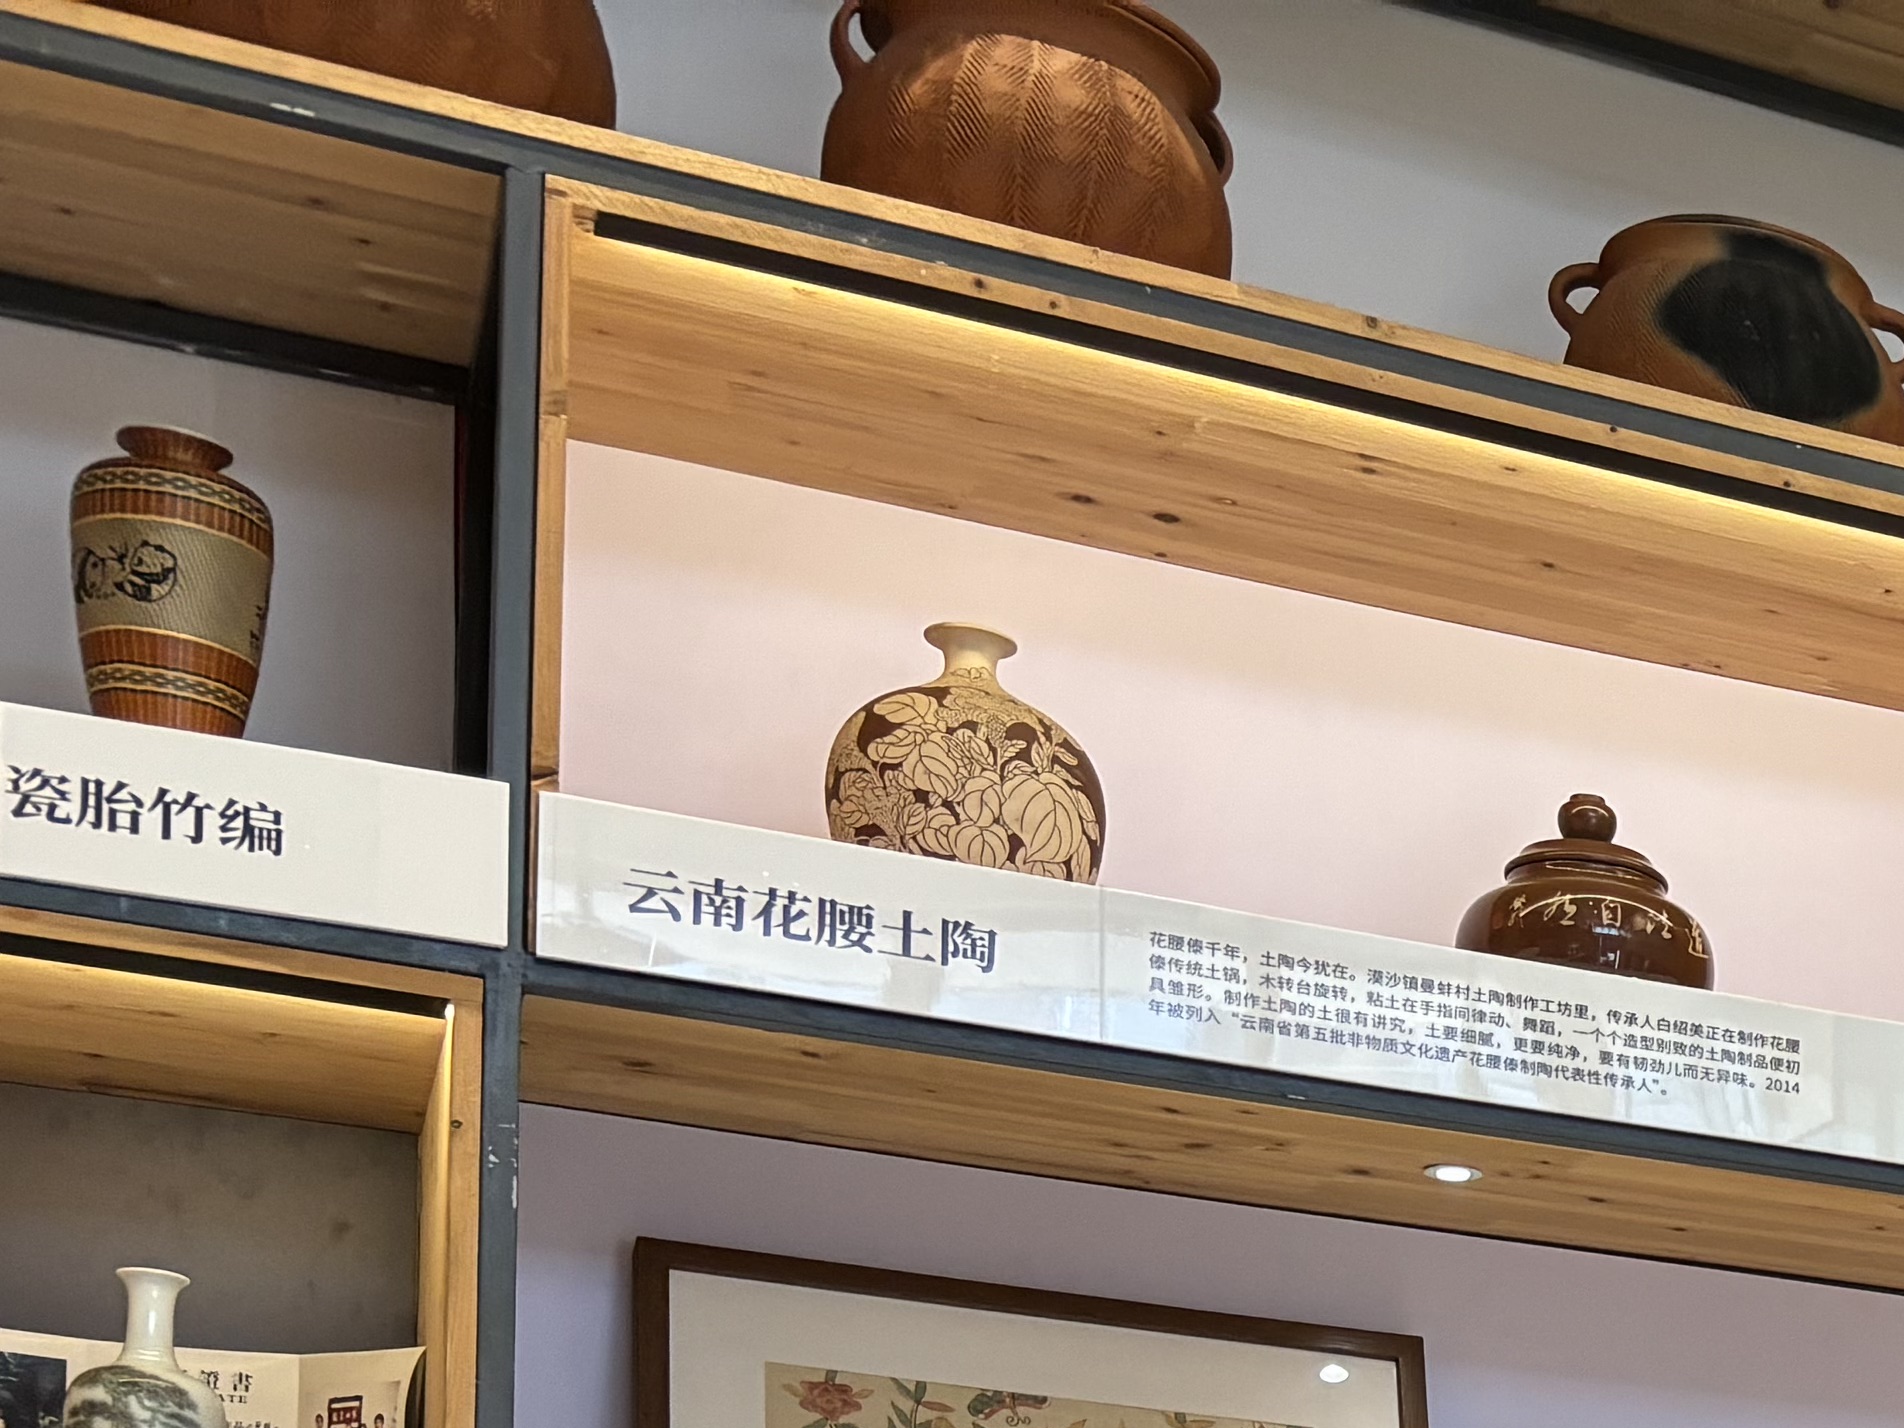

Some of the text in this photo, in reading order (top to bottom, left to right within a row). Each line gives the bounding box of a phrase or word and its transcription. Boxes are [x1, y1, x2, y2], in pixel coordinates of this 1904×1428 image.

[4, 763, 284, 856] 瓷胎竹编
[622, 867, 998, 974] 云南花腰土陶
